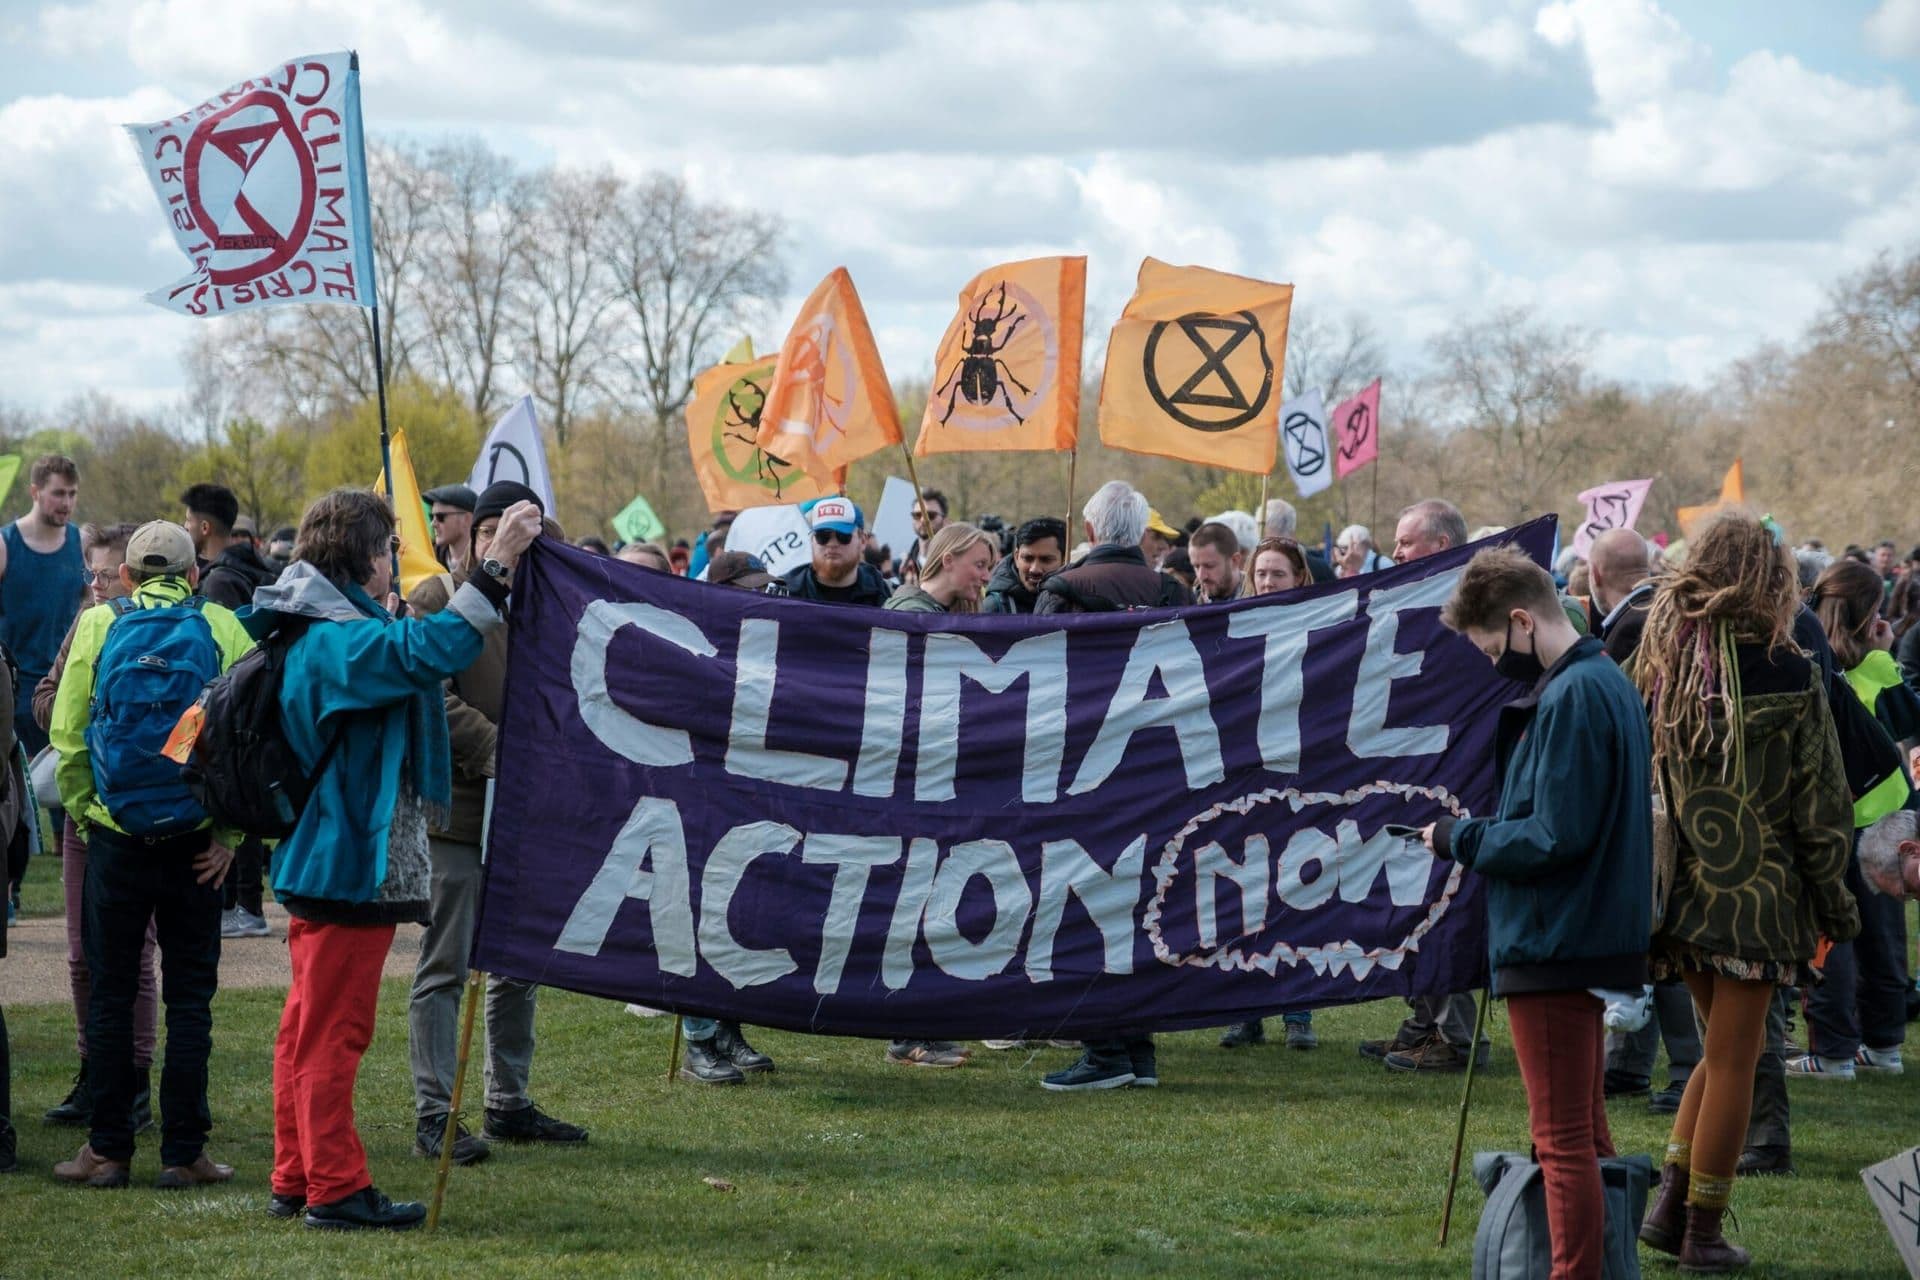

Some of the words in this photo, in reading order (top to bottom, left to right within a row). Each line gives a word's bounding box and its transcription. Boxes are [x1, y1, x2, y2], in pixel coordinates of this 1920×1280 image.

[185, 259, 317, 315] CRISIS
[301, 107, 357, 300] CLIMATE
[819, 504, 844, 516] YETI
[570, 565, 1466, 803] CLIMATE
[553, 795, 1147, 994] ACTION
[1194, 818, 1435, 950] NOW
